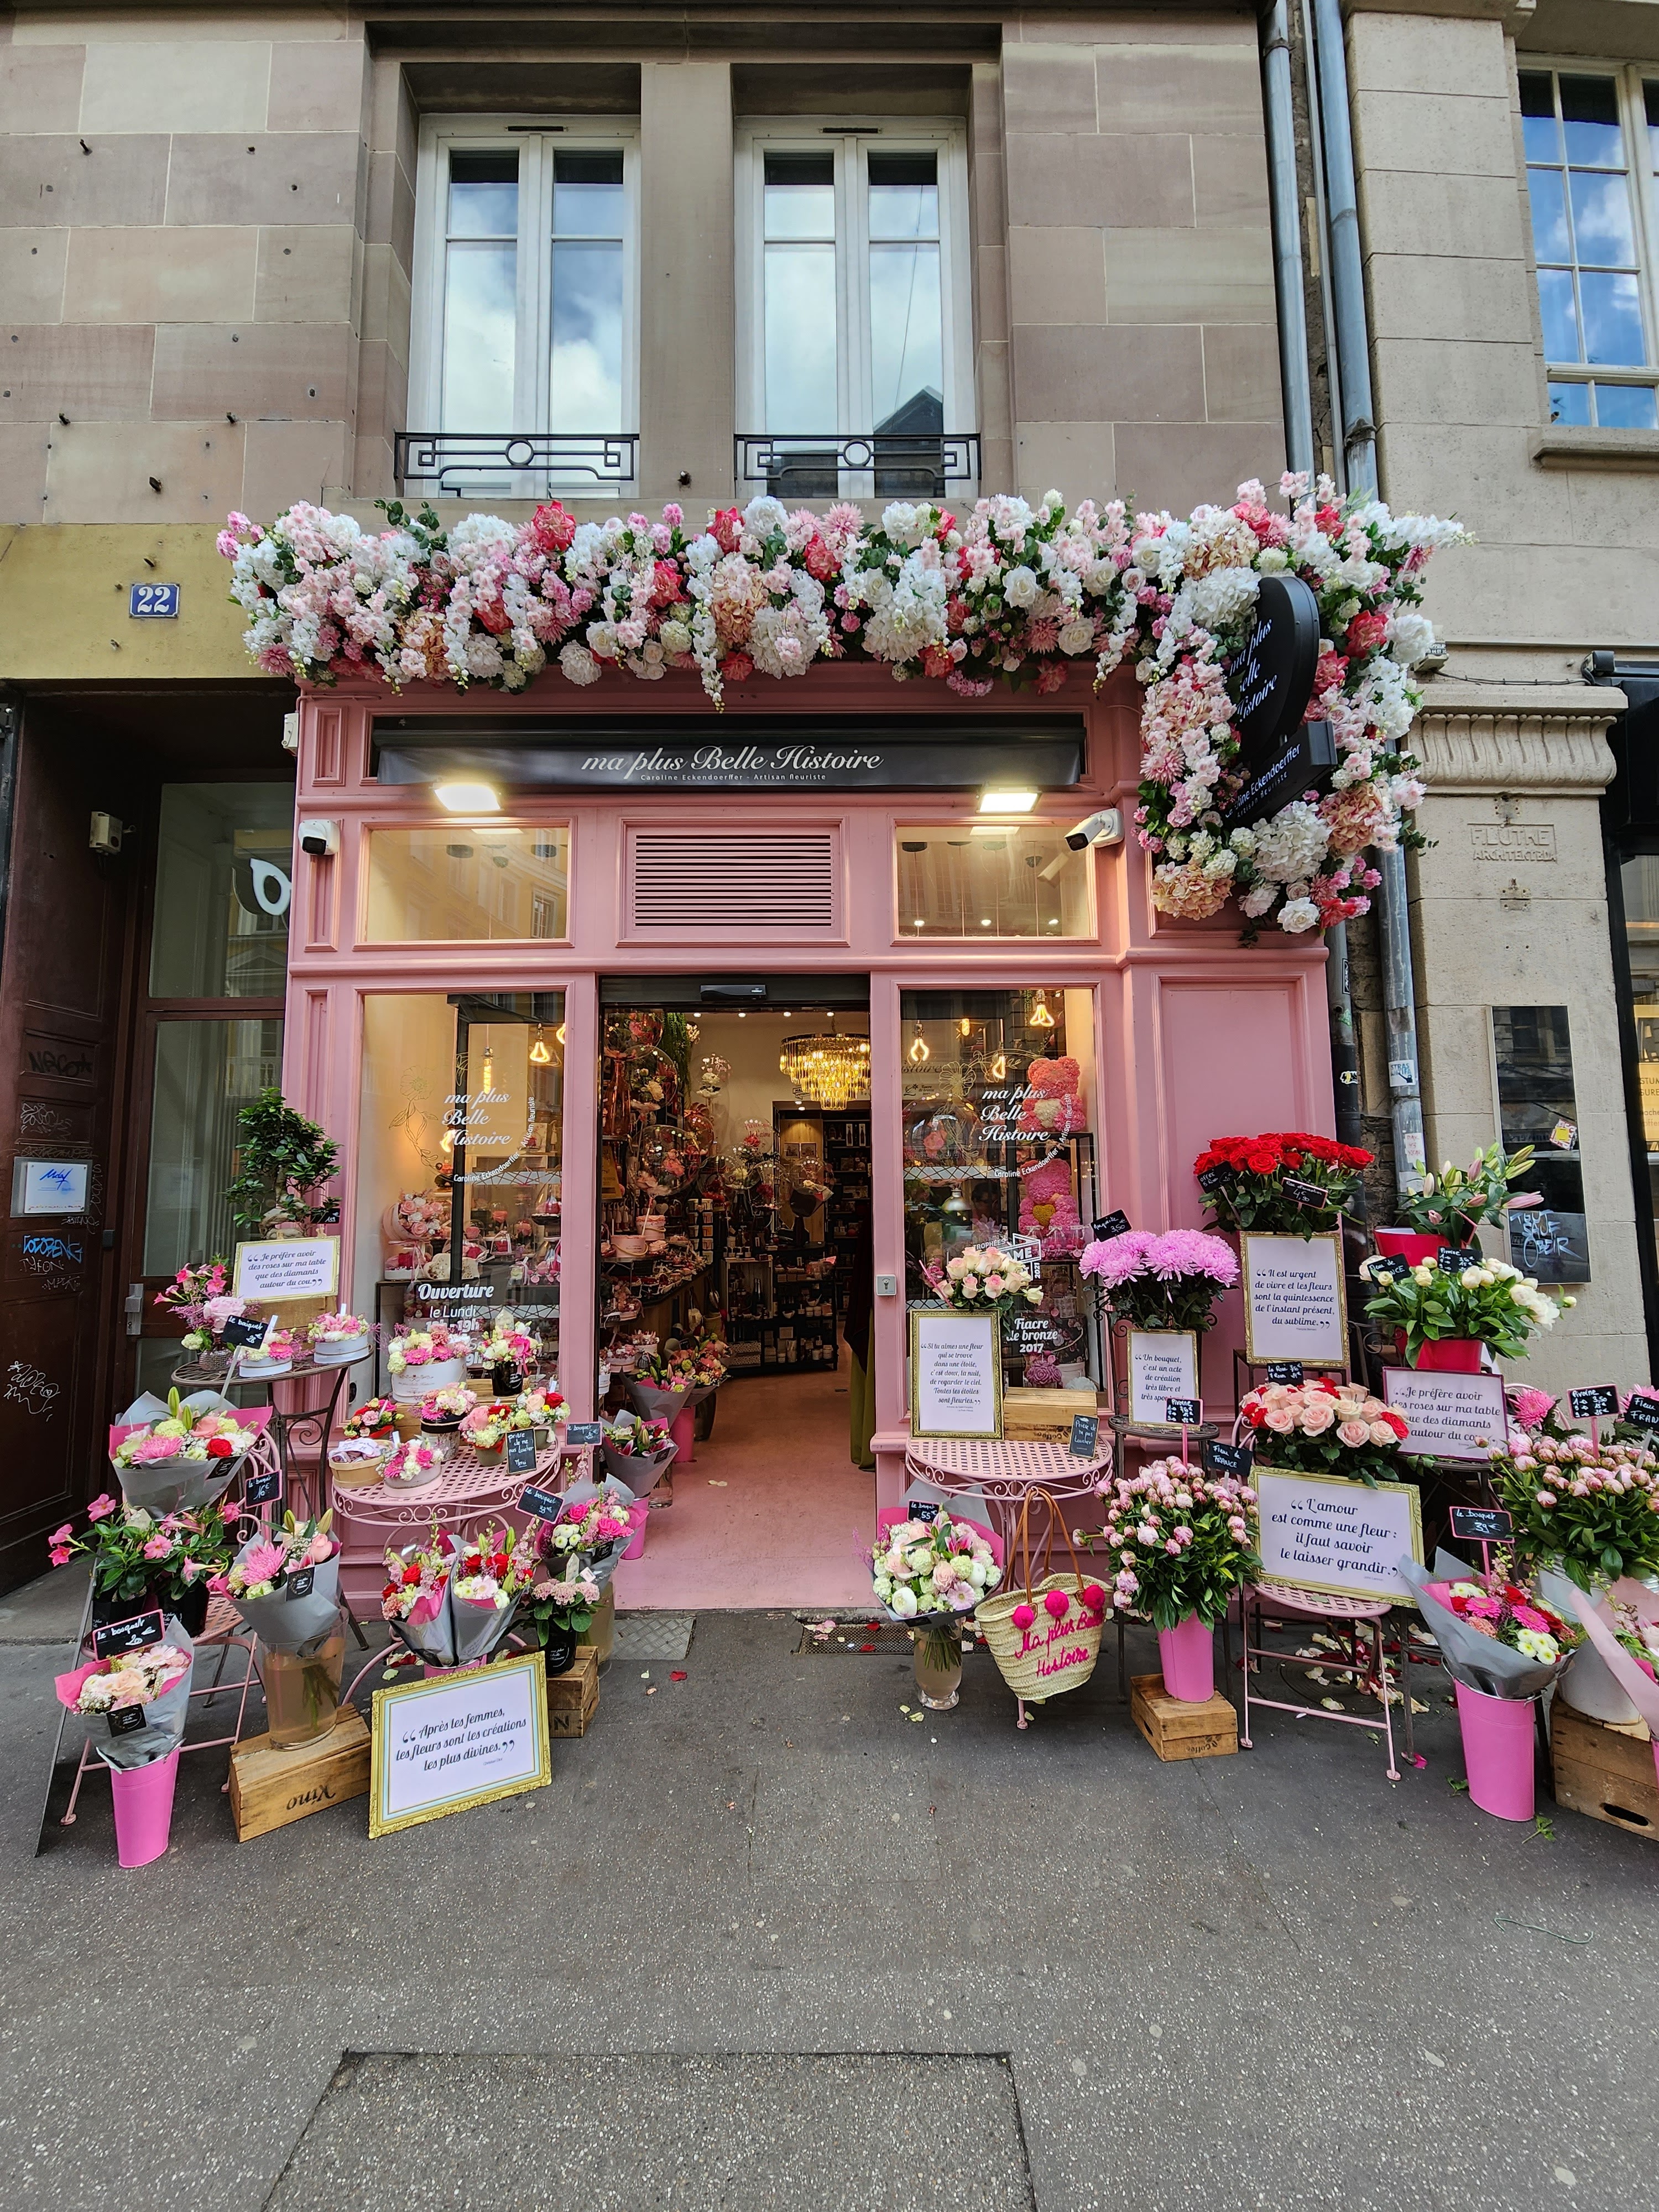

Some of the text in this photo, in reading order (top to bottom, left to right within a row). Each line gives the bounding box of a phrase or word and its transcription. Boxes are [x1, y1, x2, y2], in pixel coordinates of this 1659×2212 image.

[138, 587, 170, 613] 22
[1246, 618, 1272, 666] plus
[581, 745, 884, 779] ma plus Belle Histoire
[444, 1088, 512, 1109] ma plus
[982, 1084, 1048, 1105] ma plus
[442, 1109, 491, 1125] Belle
[980, 1105, 1029, 1121] Belle
[520, 1124, 535, 1147] Artisan
[978, 1124, 1051, 1141] Histoire
[1060, 1120, 1071, 1144] Artisan
[453, 1151, 521, 1182] Caroline Eckendoerffer
[994, 1147, 1059, 1178] Caroline Eckendoerffer
[270, 1251, 296, 1261] préfère
[255, 1273, 269, 1281] que
[284, 1269, 319, 1277] diamants
[1290, 1271, 1316, 1280] urgent
[418, 1284, 494, 1300] Ouverture
[1307, 1282, 1332, 1292] fleurs
[1283, 1293, 1334, 1303] quintessence
[430, 1304, 476, 1318] le Lundi
[1302, 1306, 1334, 1315] présent,
[1014, 1318, 1048, 1330] Fiacre
[1021, 1329, 1058, 1341] bronze
[1019, 1343, 1044, 1353] 2017
[1154, 1355, 1182, 1364] bouquet,
[1154, 1374, 1181, 1383] création
[1418, 1388, 1483, 1401] préfère avoir
[1572, 1389, 1599, 1398] Pivoine
[1391, 1400, 1407, 1408] des
[1410, 1402, 1434, 1411] roses
[1475, 1406, 1501, 1416] table
[1423, 1415, 1491, 1429] des diamants
[1411, 1429, 1462, 1441] autour du
[1213, 1454, 1238, 1469] FRANCE
[1234, 1450, 1241, 1460] de
[525, 1486, 556, 1505] Le bouquet
[921, 1510, 937, 1520] 55€
[1457, 1509, 1496, 1520] Le bouquet
[1271, 1514, 1391, 1538] est comme une fleur
[1296, 1532, 1374, 1554] il faut savoir
[1280, 1548, 1334, 1566] le laisser
[97, 1631, 107, 1641] Le
[111, 1617, 145, 1636] bouquet
[1015, 1617, 1075, 1659] Ma plus
[451, 1708, 505, 1729] les femmes,
[396, 1718, 526, 1761] les fleurs sont les créations
[424, 1752, 461, 1771] les plus
